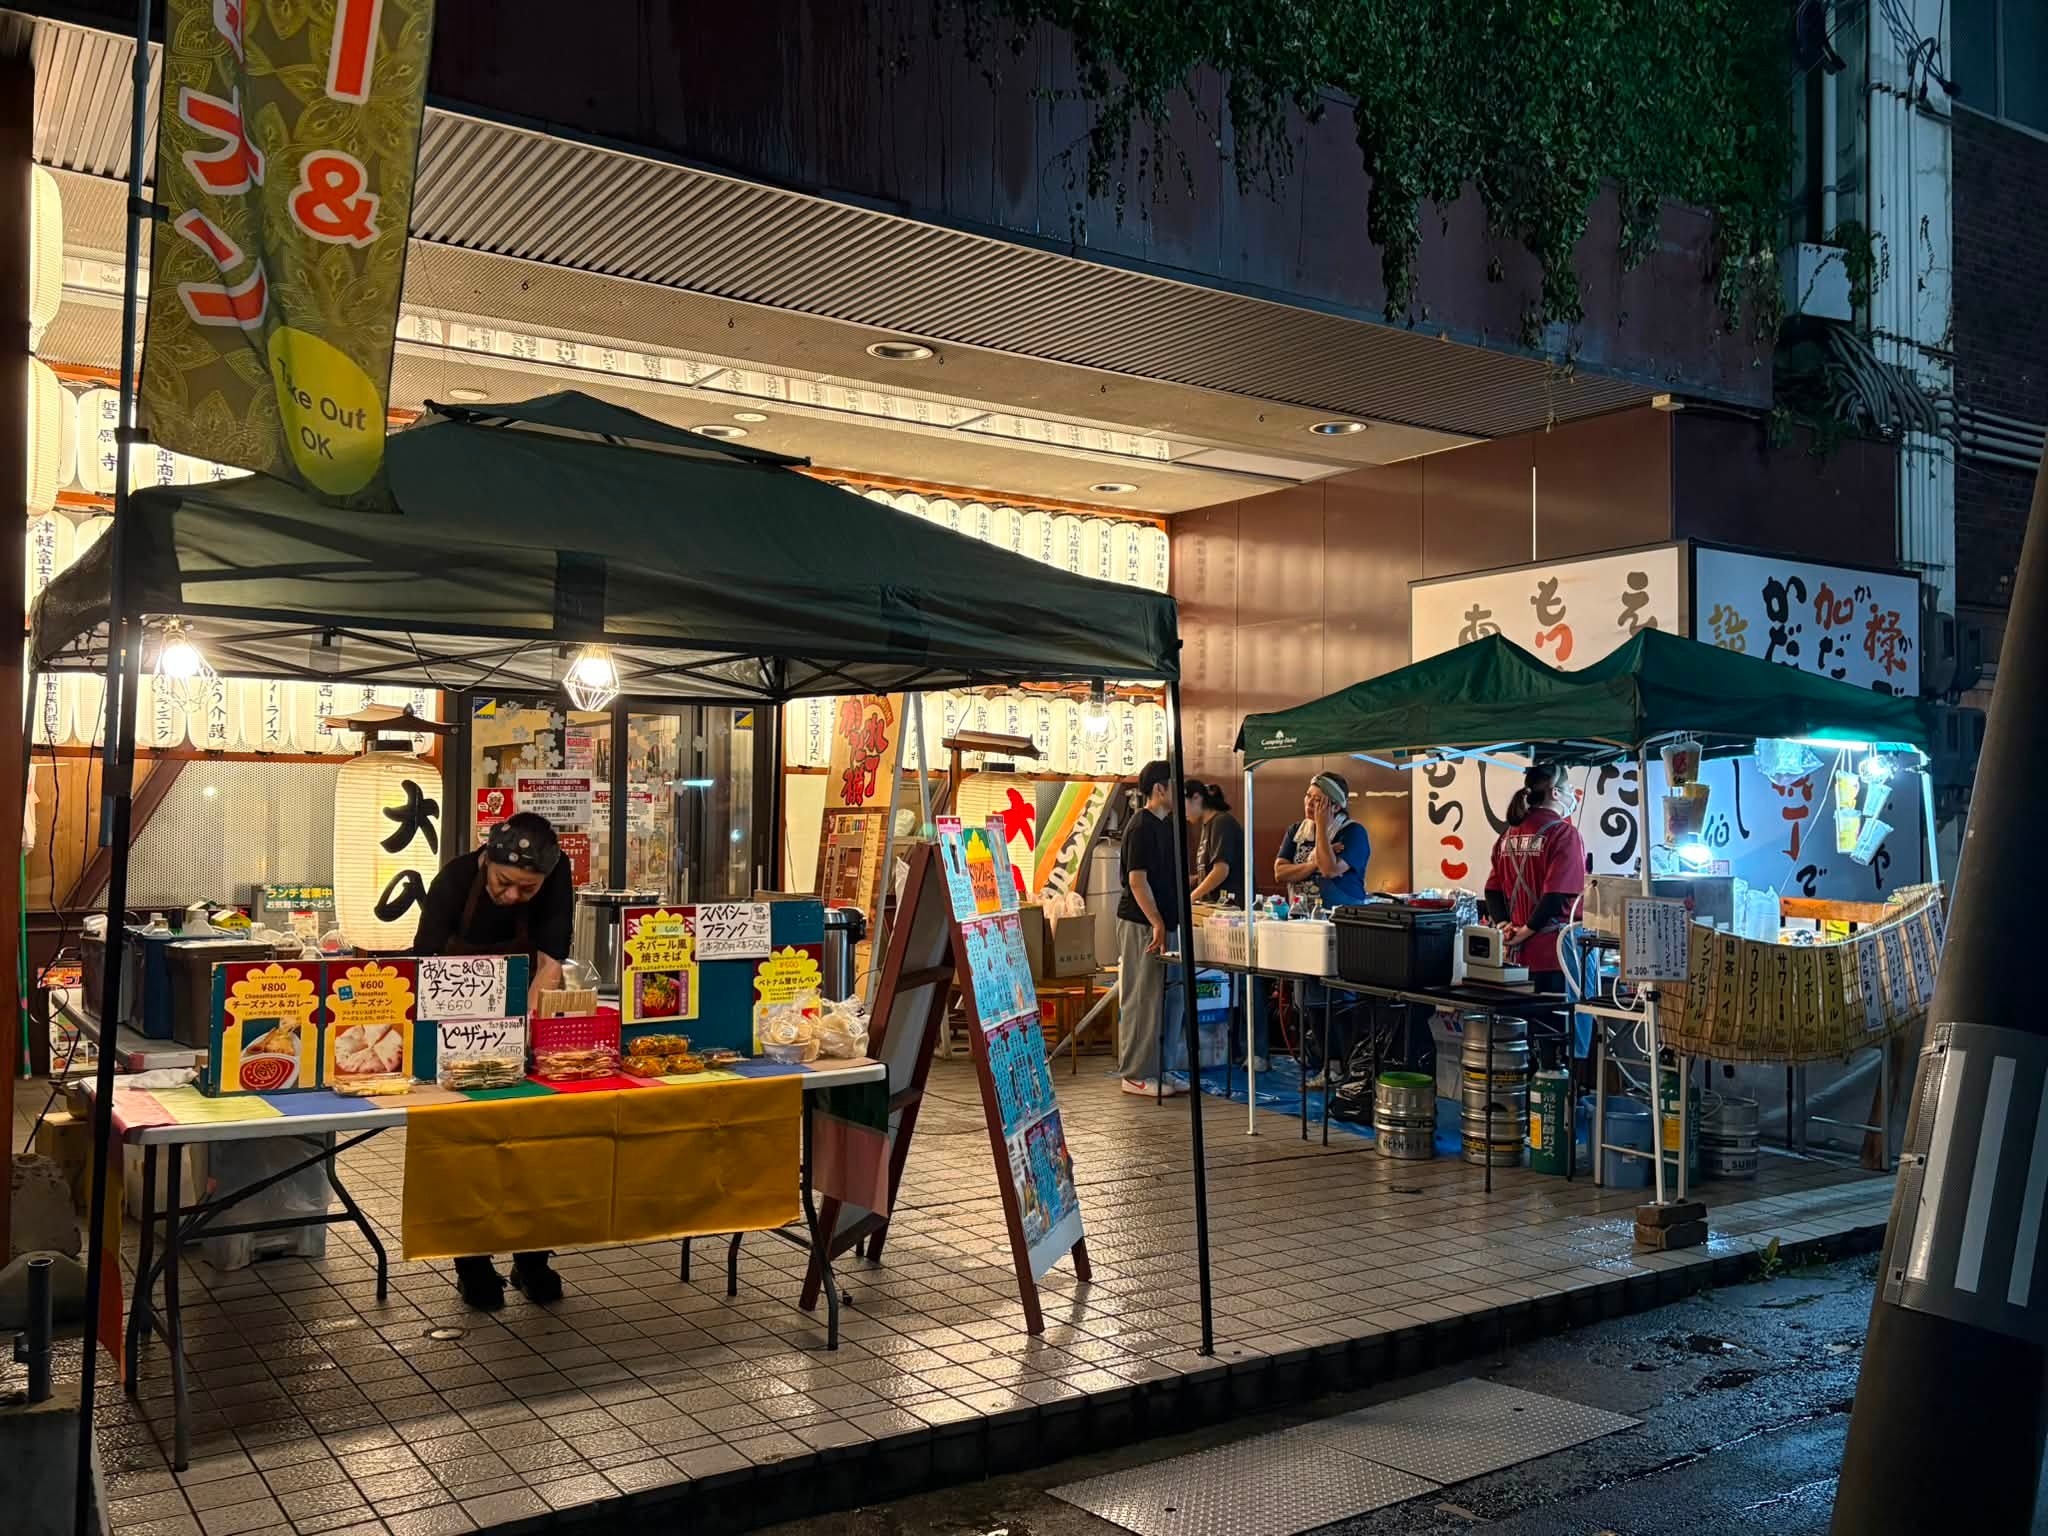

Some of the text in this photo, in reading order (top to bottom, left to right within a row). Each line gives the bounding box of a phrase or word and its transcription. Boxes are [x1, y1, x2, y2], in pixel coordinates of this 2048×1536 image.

[320, 397, 367, 431] Out
[301, 426, 333, 460] OK
[700, 904, 749, 922] スパイシー
[702, 922, 749, 939] フランク
[636, 939, 688, 951] ネパール風
[261, 982, 287, 992] ¥800
[360, 980, 384, 989] ¥600
[351, 998, 393, 1008] チーズナン
